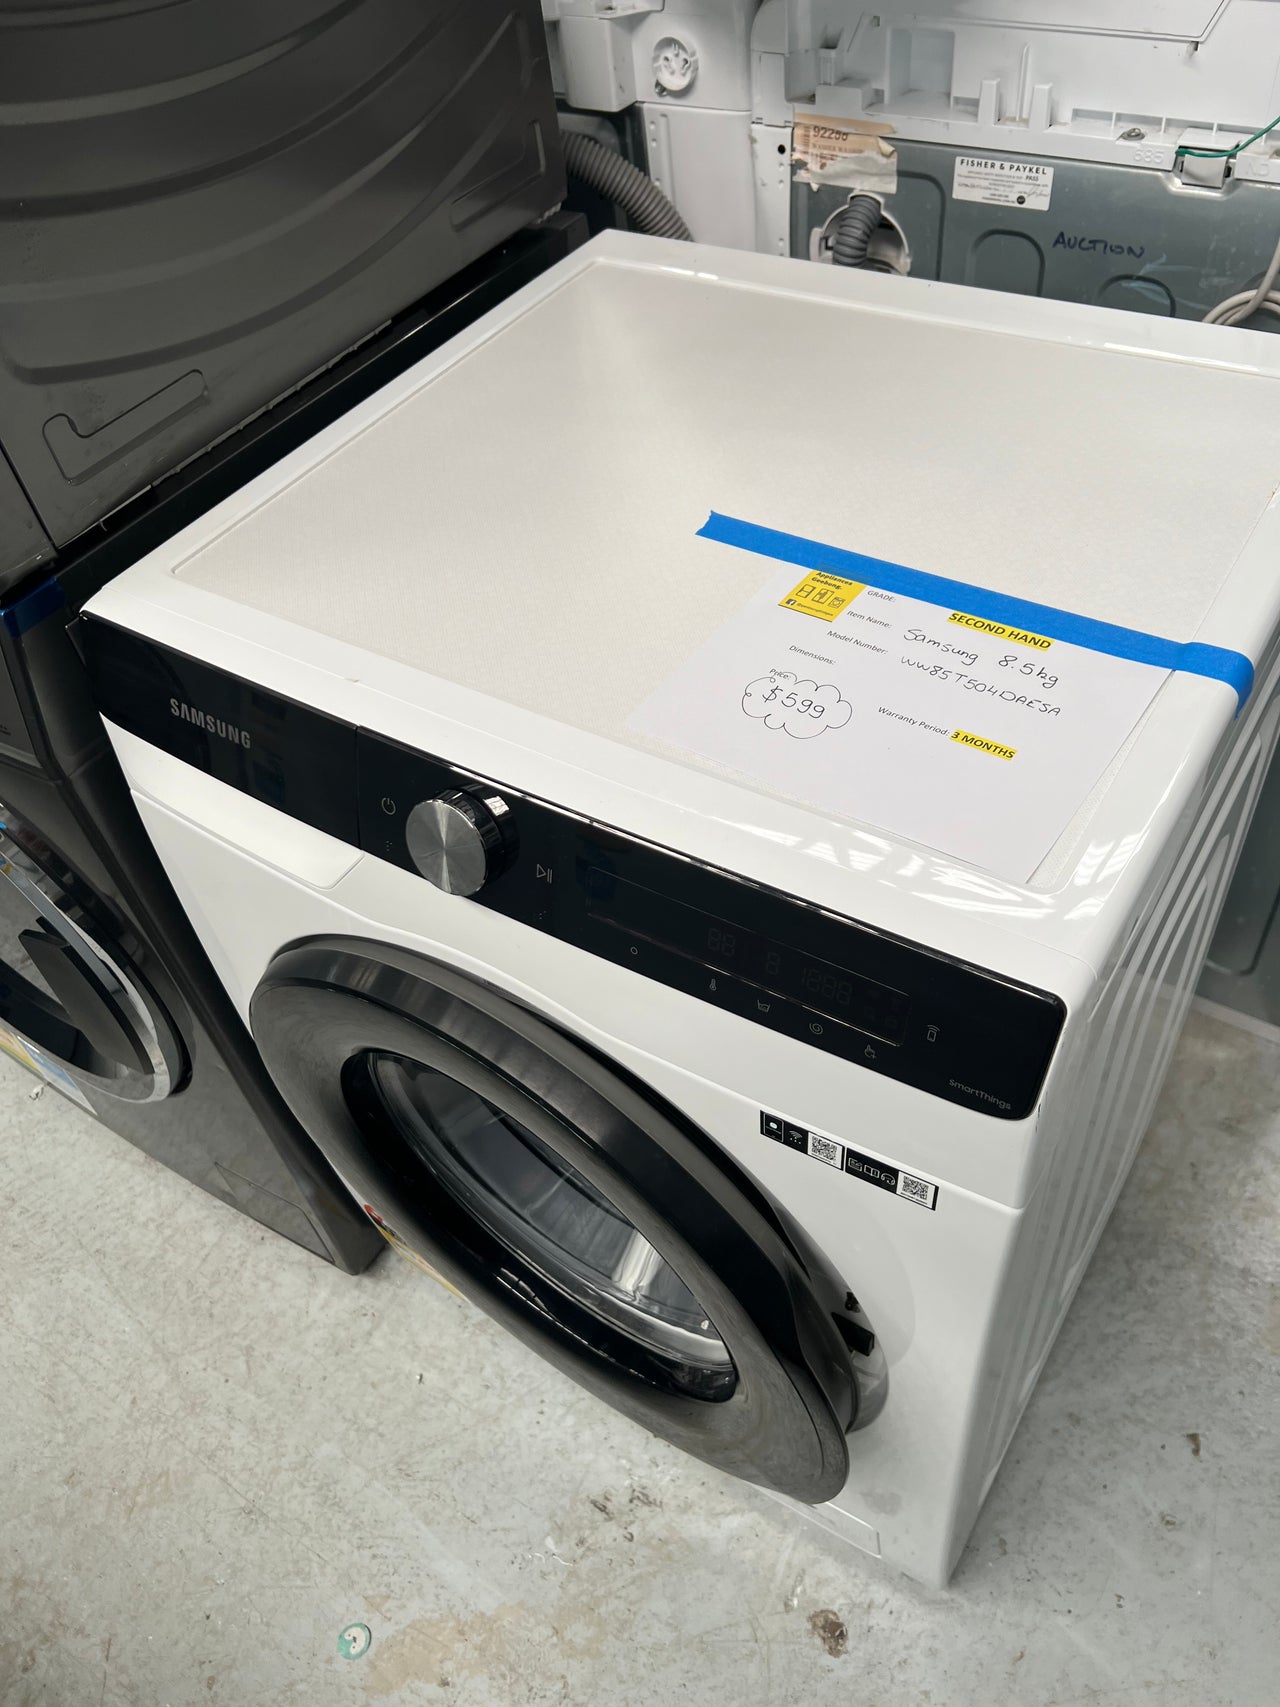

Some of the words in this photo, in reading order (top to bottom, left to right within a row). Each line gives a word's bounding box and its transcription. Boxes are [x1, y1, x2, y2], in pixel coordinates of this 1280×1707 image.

[960, 158, 996, 169] FISHER
[999, 163, 1005, 171] &
[1009, 164, 1047, 175] PAYKEL
[1052, 231, 1145, 259] AUCTION
[816, 572, 853, 586] Appliances
[867, 590, 896, 603] GRADE:
[847, 610, 865, 621] Item
[866, 615, 893, 629] Name:
[949, 612, 1006, 635] SECOND
[1007, 630, 1051, 649] HAND
[789, 645, 837, 666] Dimensions:
[827, 630, 852, 643] Model
[854, 640, 888, 655] Number:
[903, 628, 979, 666] Samsung
[769, 668, 792, 681] Price:
[762, 685, 826, 719] $599
[170, 698, 251, 749] SAMSUNG
[878, 706, 917, 726] Warranty
[918, 721, 950, 737] Period:
[951, 731, 960, 740] 3
[961, 735, 1016, 759] MONTHS
[948, 1079, 1011, 1110] SmartThings
